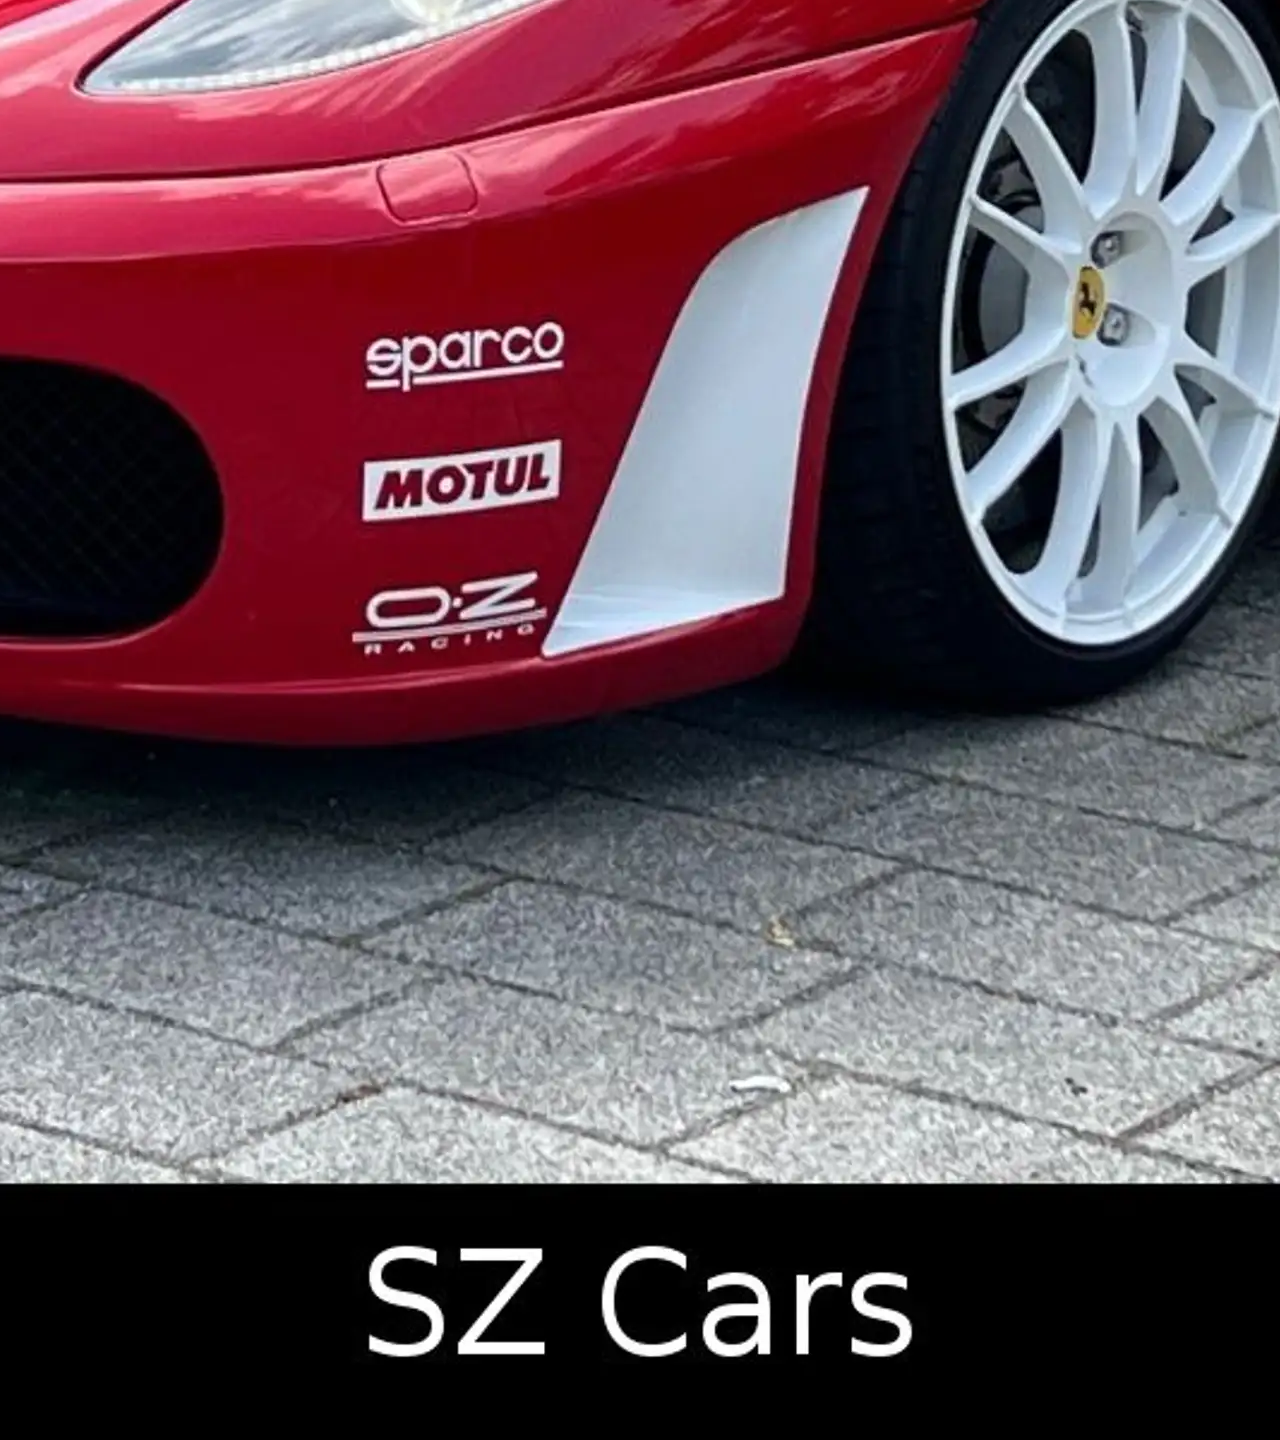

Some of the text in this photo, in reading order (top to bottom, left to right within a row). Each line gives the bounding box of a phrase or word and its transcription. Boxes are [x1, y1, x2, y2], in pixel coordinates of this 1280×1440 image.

[366, 321, 565, 392] sparco
[374, 452, 550, 511] MOTUL
[363, 623, 535, 656] RACING
